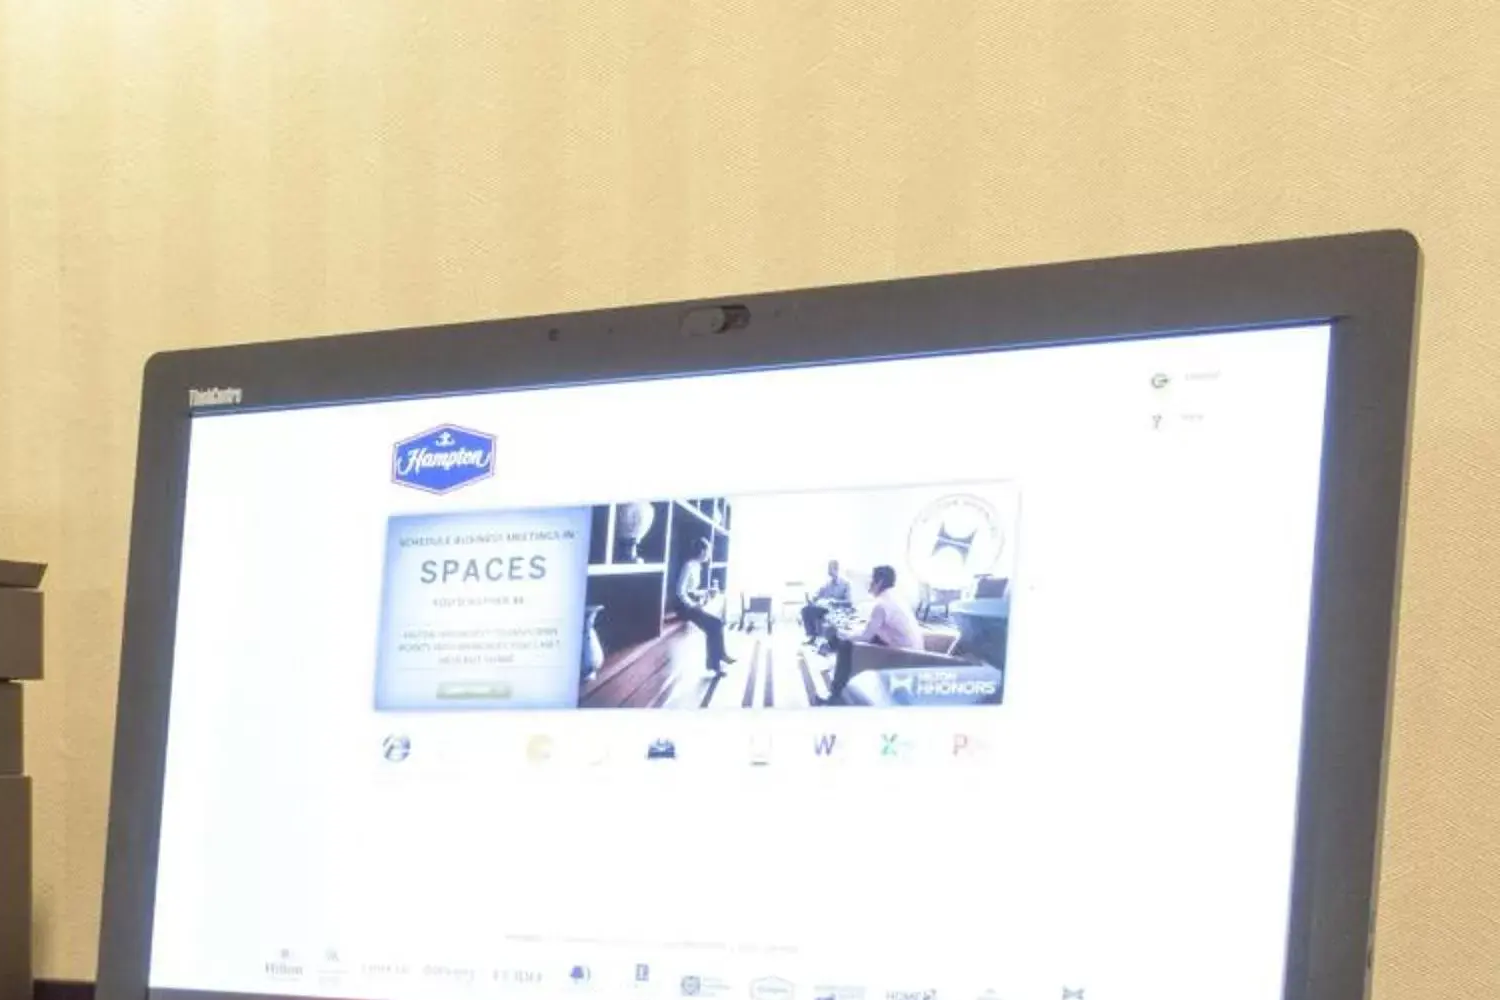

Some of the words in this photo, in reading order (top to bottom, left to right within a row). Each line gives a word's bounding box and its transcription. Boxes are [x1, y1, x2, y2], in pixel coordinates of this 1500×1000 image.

[397, 446, 491, 476] Hampton
[419, 554, 548, 585] SPACES
[918, 680, 996, 696] HHONORS
